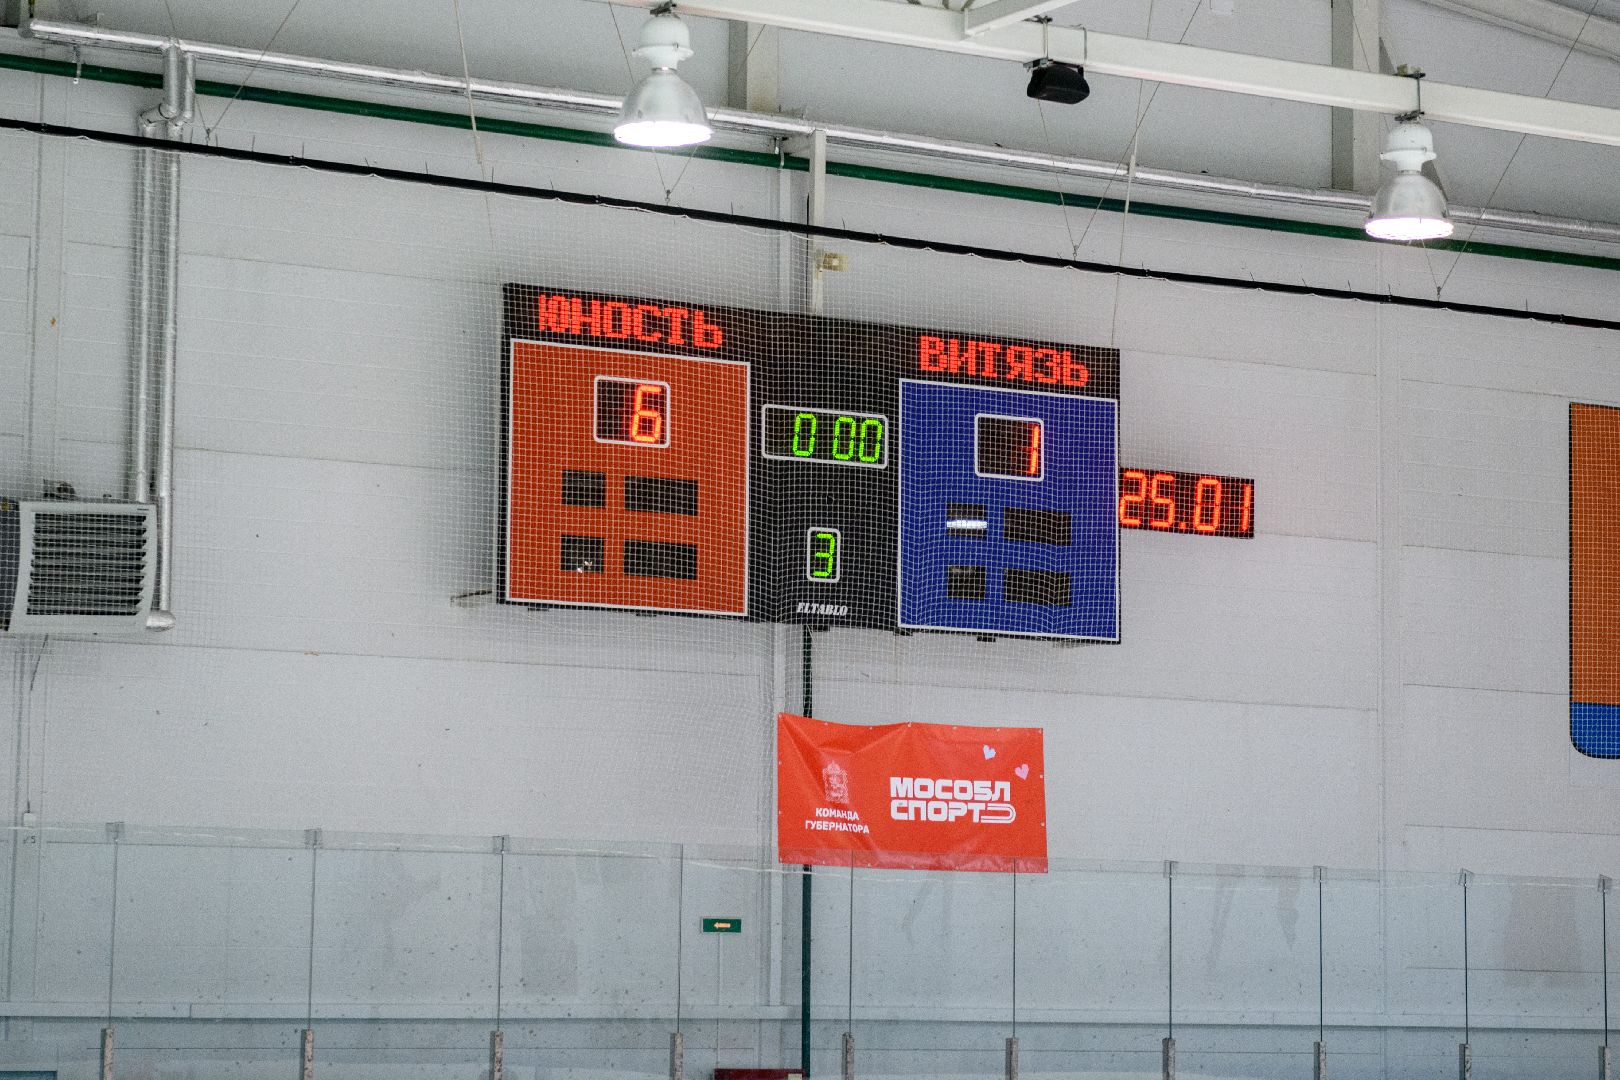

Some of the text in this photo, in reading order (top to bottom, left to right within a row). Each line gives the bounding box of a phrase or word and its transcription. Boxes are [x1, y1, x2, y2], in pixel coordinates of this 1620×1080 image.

[539, 292, 723, 349] ЮНОСТЬ
[919, 335, 1090, 387] ВИТЯЗЬ
[630, 383, 663, 443] 6
[1029, 423, 1041, 475] 1
[1118, 470, 1253, 533] 25.01
[812, 532, 836, 577] 3
[796, 602, 849, 616] ELTABLO
[889, 776, 1011, 802] МОСОБЛ
[804, 819, 870, 834] ГУБЕРНАТОРА
[815, 807, 860, 821] КОМАНДА
